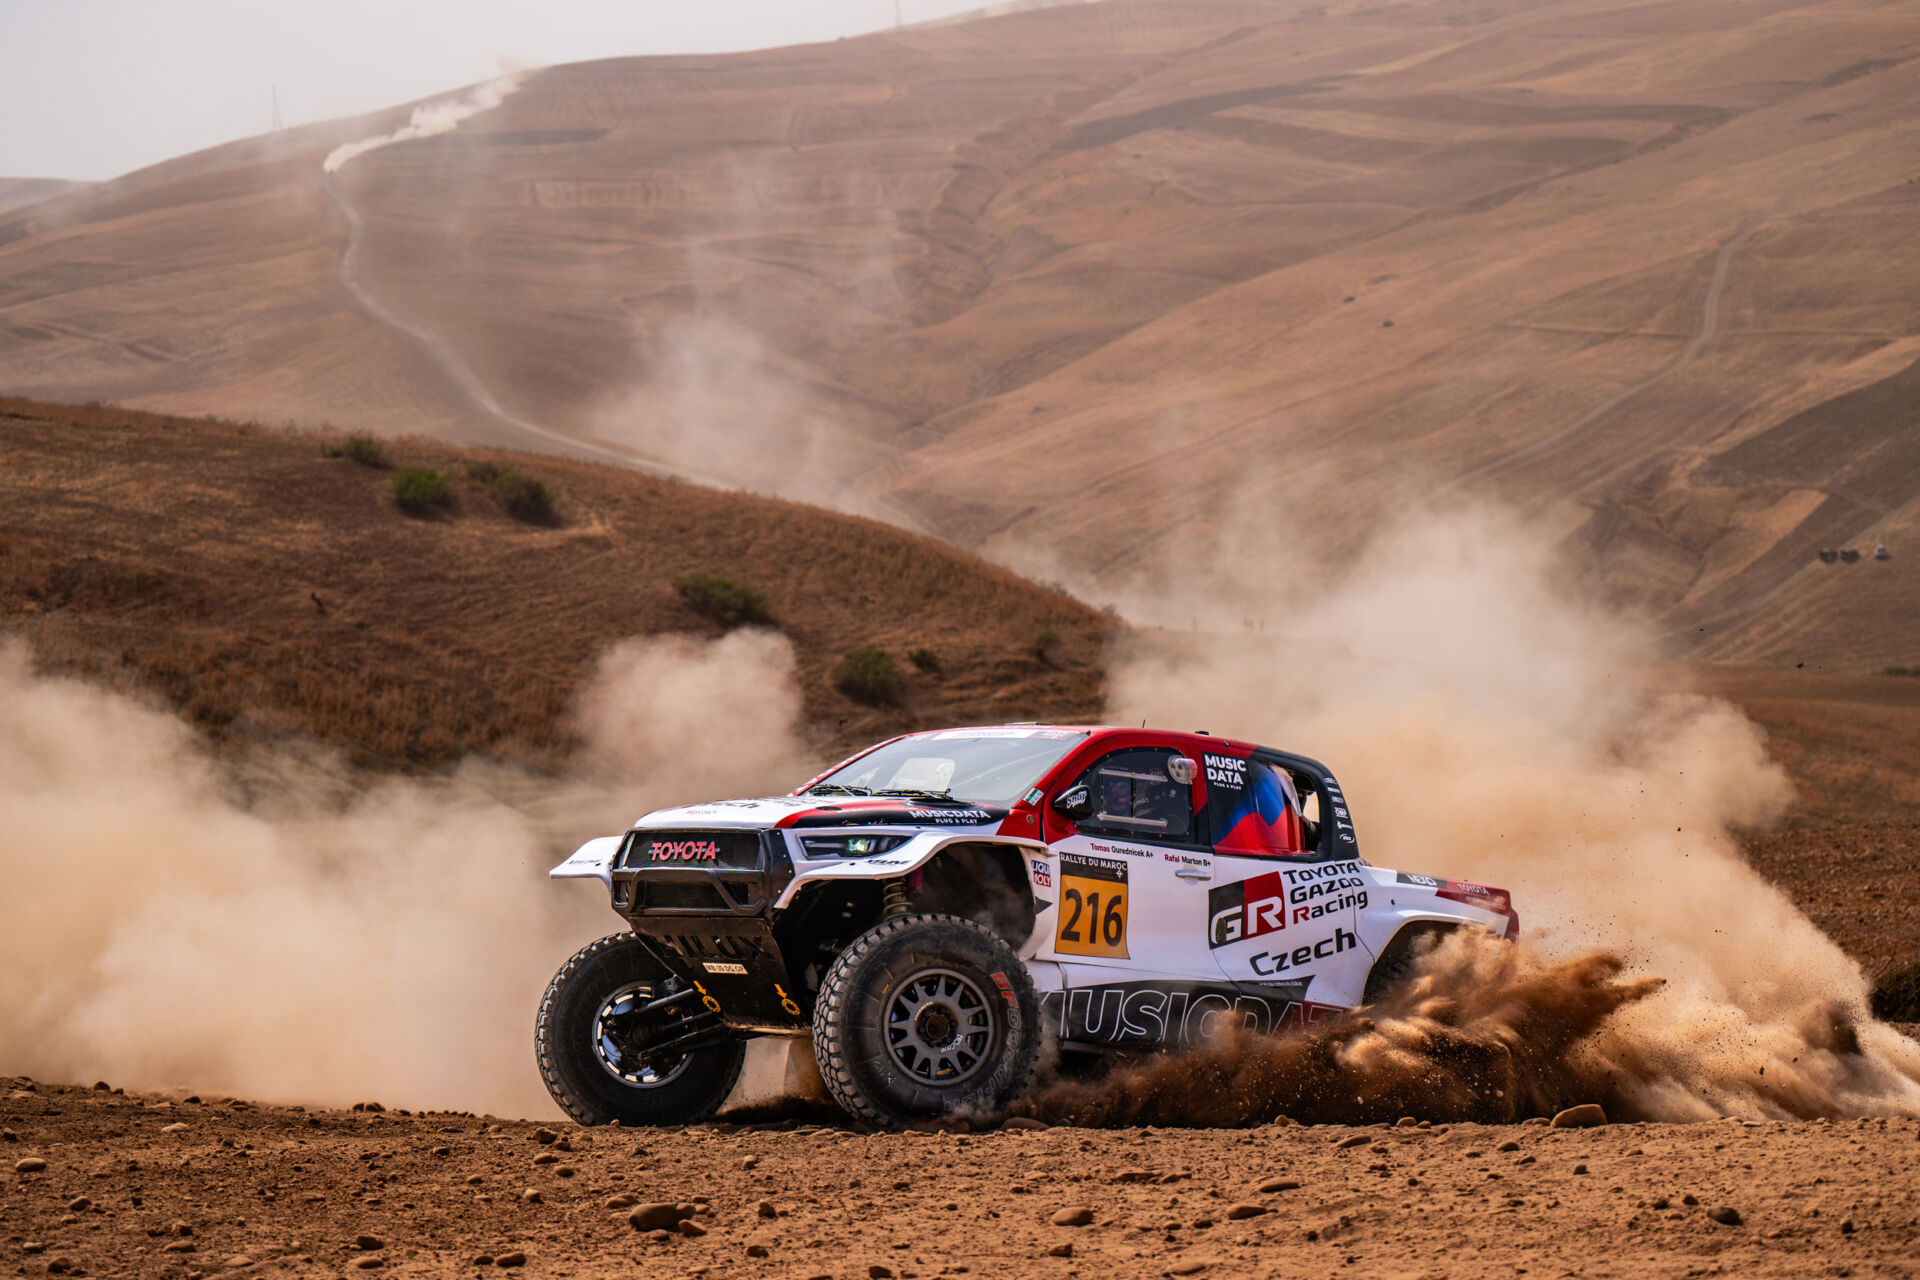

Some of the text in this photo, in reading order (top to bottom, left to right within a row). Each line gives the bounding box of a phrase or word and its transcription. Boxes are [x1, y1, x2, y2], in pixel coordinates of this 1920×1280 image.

[1204, 754, 1247, 771] MUSIC
[1206, 768, 1244, 785] DATA
[908, 810, 992, 819] MUSICDATA
[651, 840, 716, 861] TOYOTA
[1090, 842, 1111, 853] Tomas
[1145, 850, 1154, 858] A+
[1060, 853, 1128, 871] RALLYE DU MAROC
[1164, 853, 1212, 867] Rafal Marton B+
[1283, 862, 1361, 885] TOYOTA
[1289, 877, 1365, 905] GAZOO
[1456, 883, 1490, 896] TOYOTA
[1293, 890, 1369, 925] Racing
[1060, 888, 1123, 948] 216
[1210, 896, 1283, 945] GR
[1249, 928, 1357, 976] Czech
